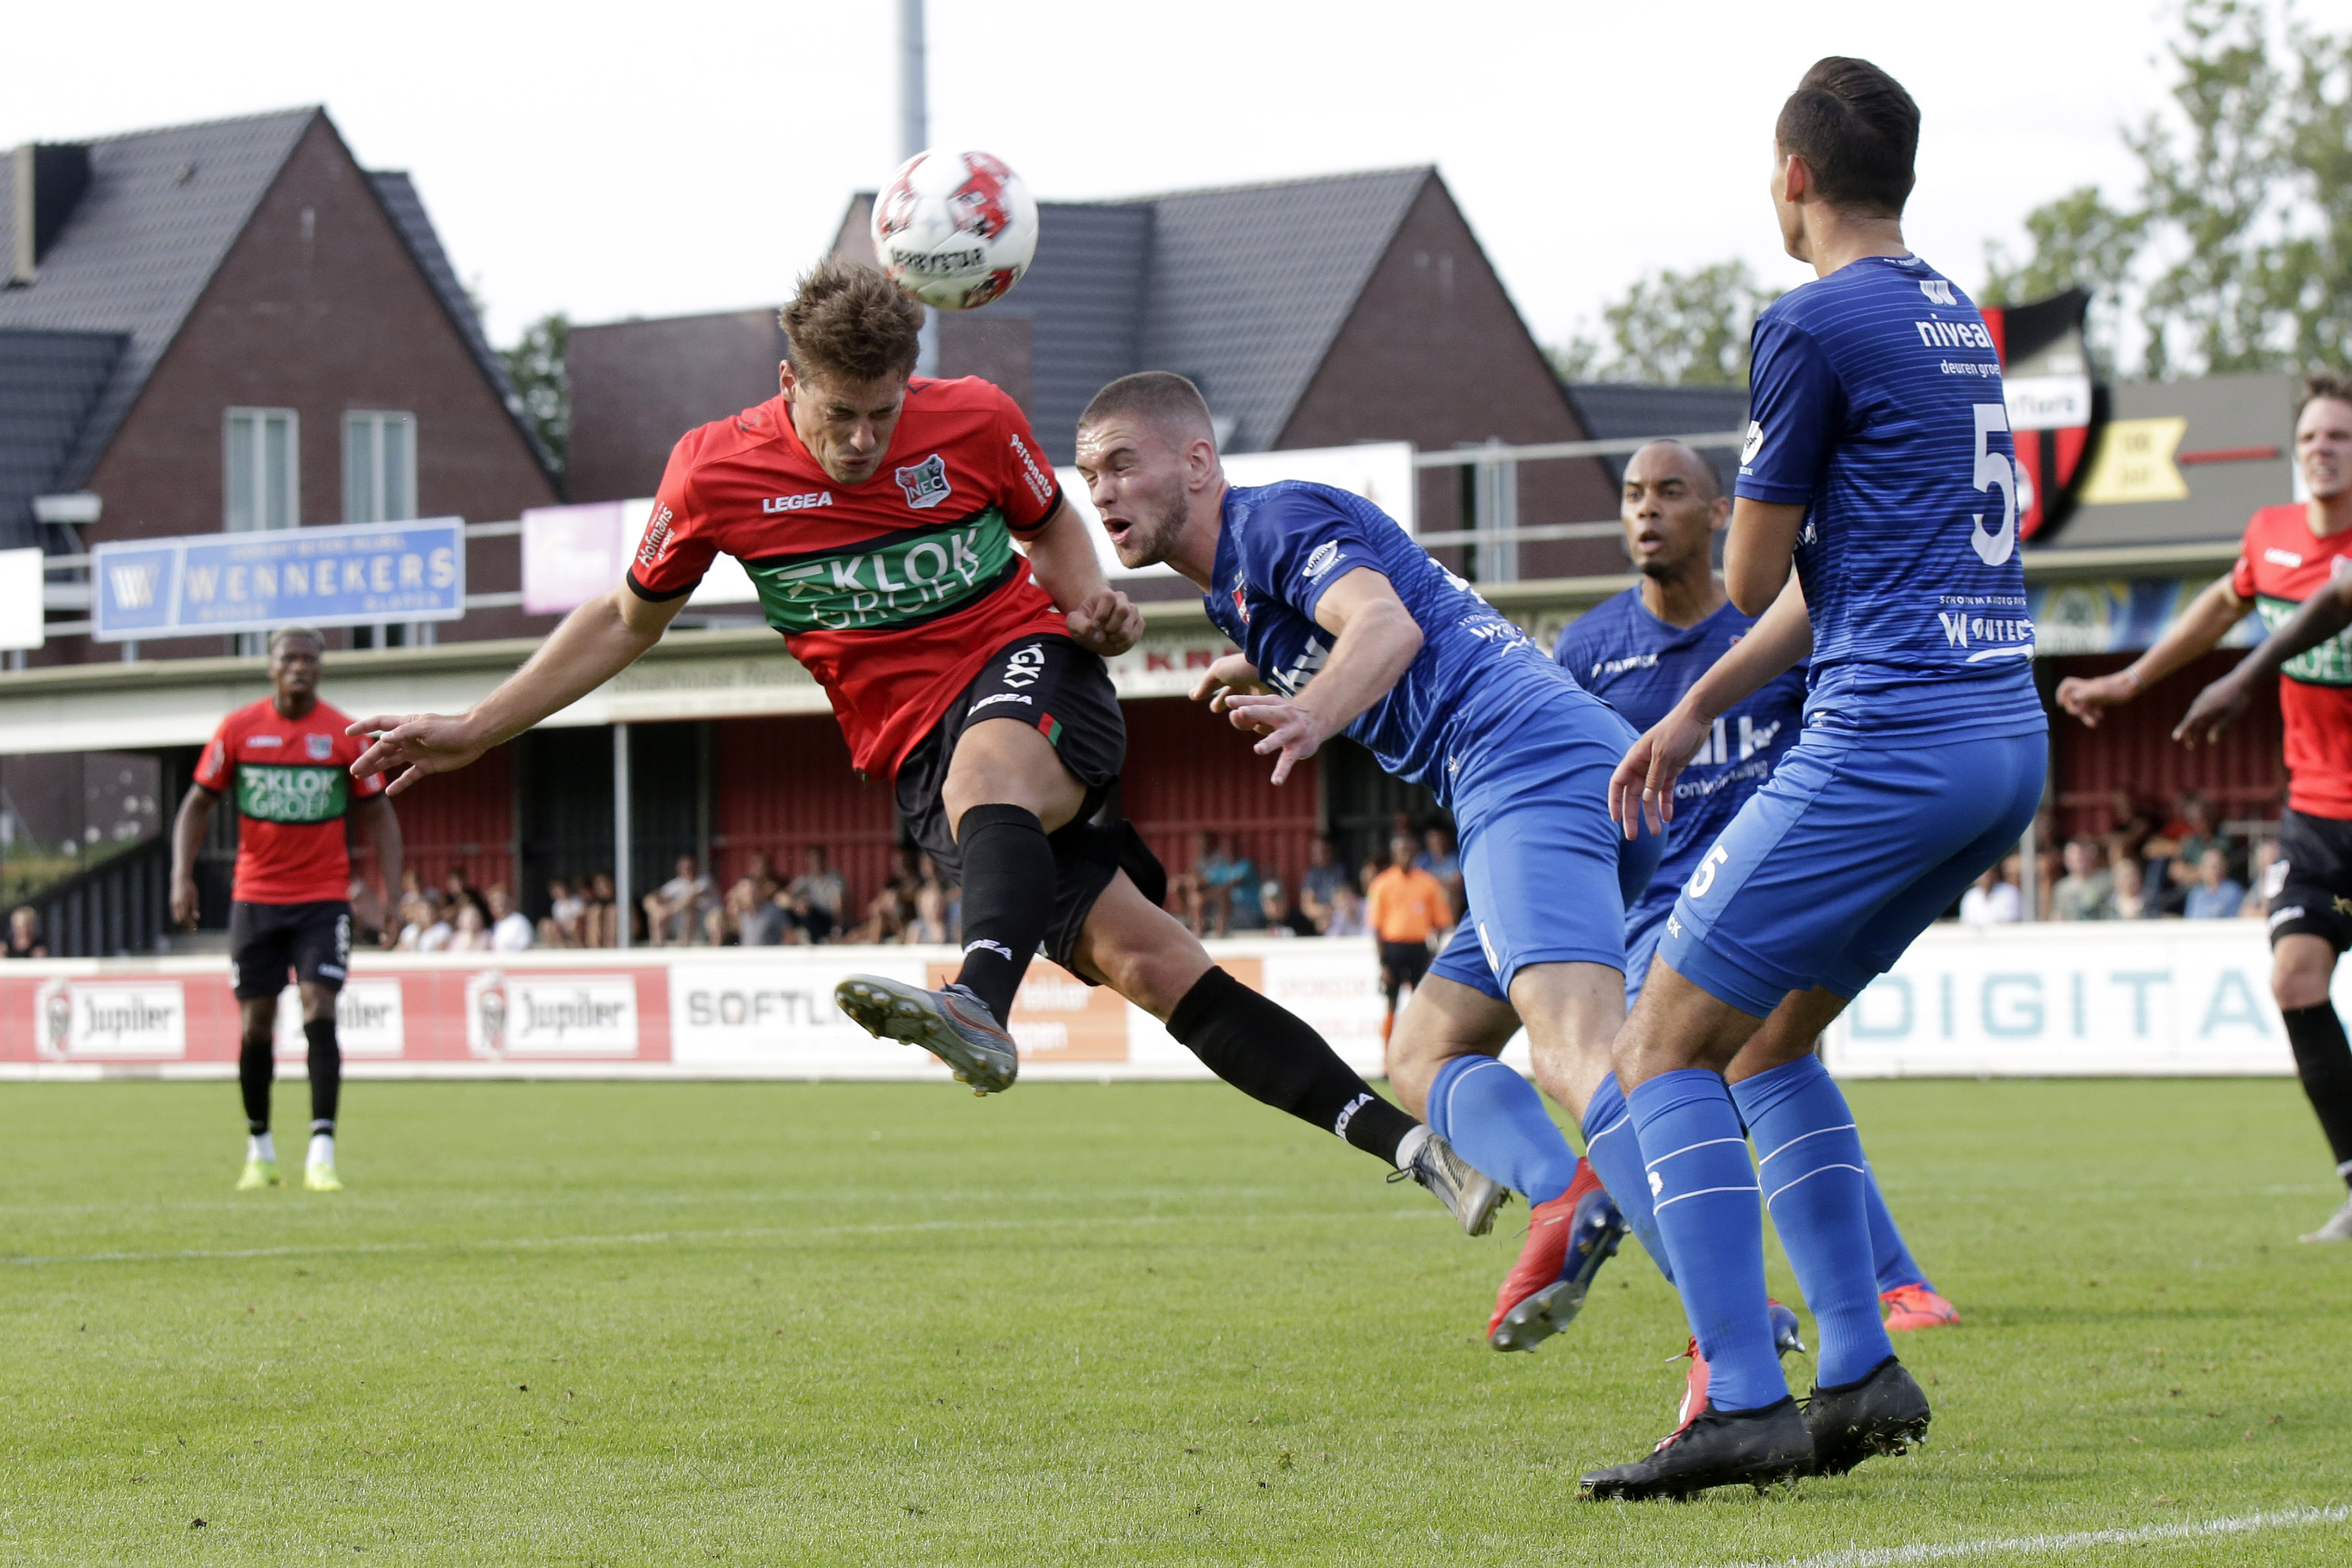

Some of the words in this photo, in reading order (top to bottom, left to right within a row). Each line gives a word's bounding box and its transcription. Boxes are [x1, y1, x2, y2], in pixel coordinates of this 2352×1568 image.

[1940, 359, 1978, 375] deuren
[908, 475, 944, 499] NEC
[1010, 433, 1054, 497] personato
[1971, 403, 2017, 568] 5
[763, 491, 833, 514] LEGEA
[637, 506, 674, 568] Hofmans
[829, 527, 980, 593] KLOK
[185, 546, 457, 604] WENNEKERS
[248, 787, 331, 821] GROEP
[264, 768, 339, 795] KLOK
[1688, 844, 1729, 899] 5
[83, 993, 175, 1044] Jupiler
[520, 988, 626, 1040] Jupiler
[1848, 969, 2275, 1042] DIGITA
